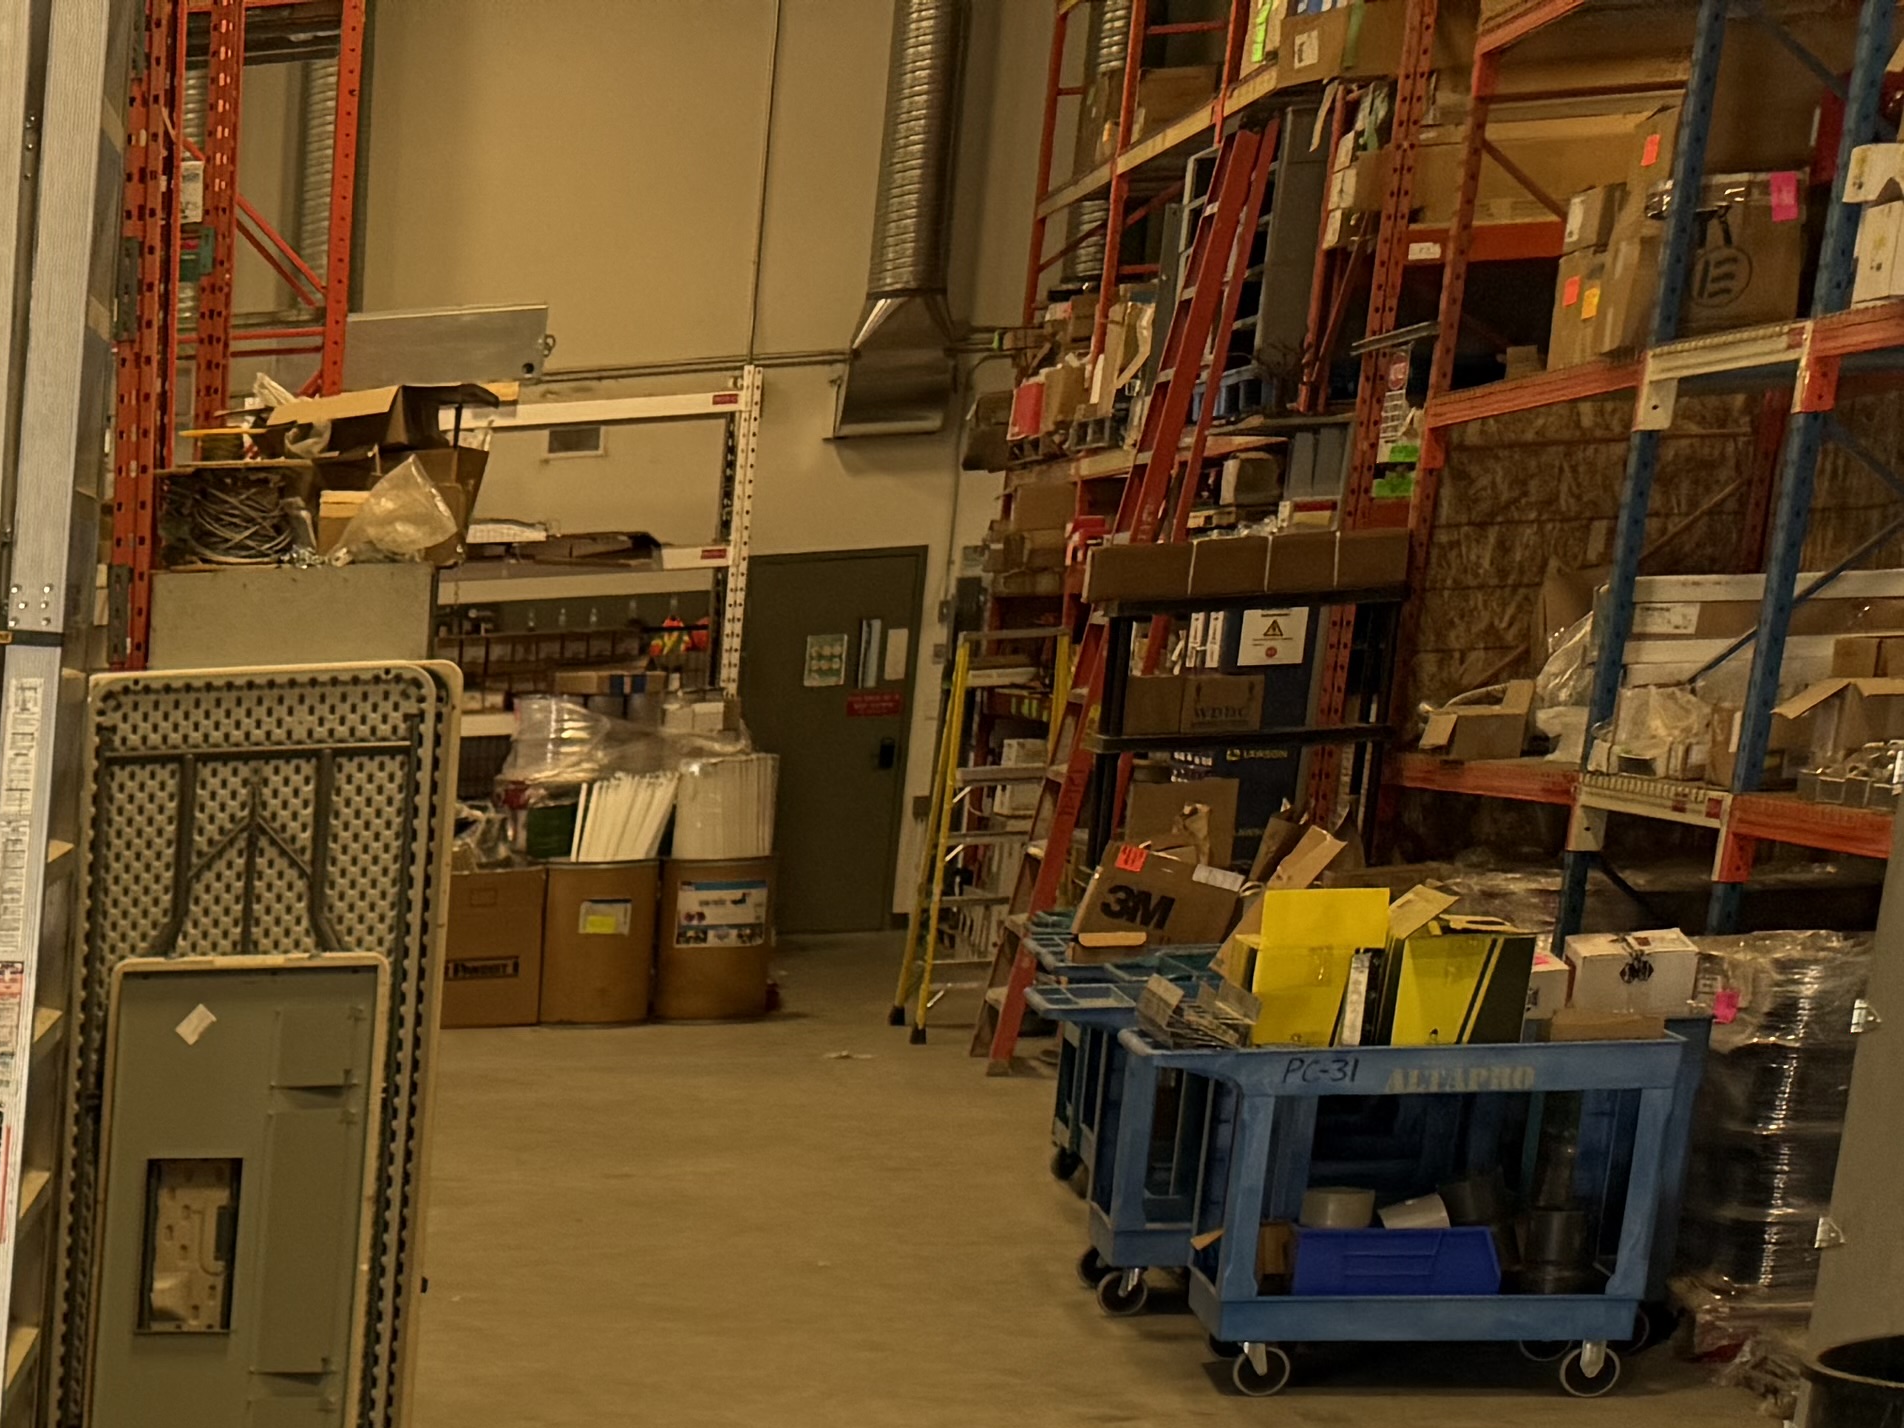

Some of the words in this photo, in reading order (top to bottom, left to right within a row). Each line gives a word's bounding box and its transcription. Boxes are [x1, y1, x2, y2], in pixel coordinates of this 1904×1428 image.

[1100, 885, 1177, 931] 3M
[1281, 1055, 1360, 1084] PC-31
[1383, 1065, 1538, 1095] ALTAPRO
